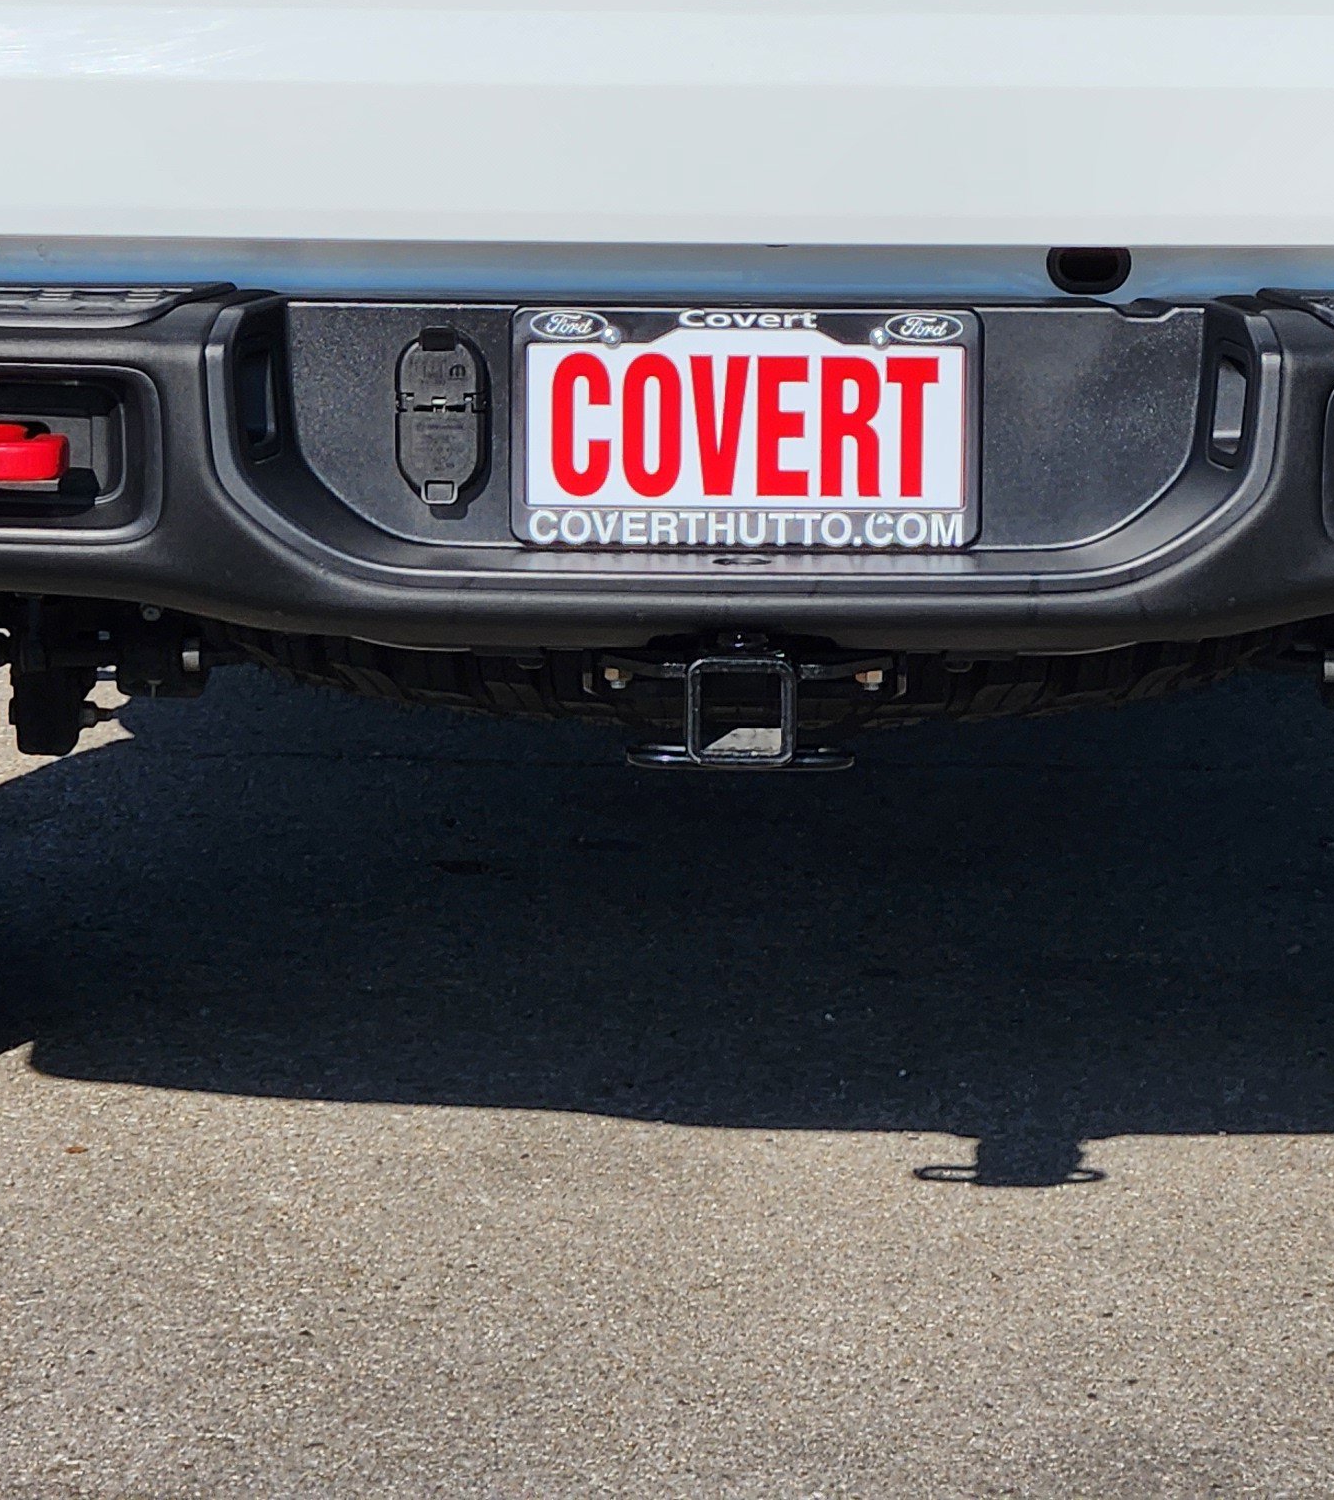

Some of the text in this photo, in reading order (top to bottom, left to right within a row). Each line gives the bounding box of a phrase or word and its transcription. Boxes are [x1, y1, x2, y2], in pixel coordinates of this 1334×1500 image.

[678, 308, 818, 329] Covert
[550, 351, 940, 499] COVERT
[528, 509, 965, 547] COVERTHUTTO.COM
